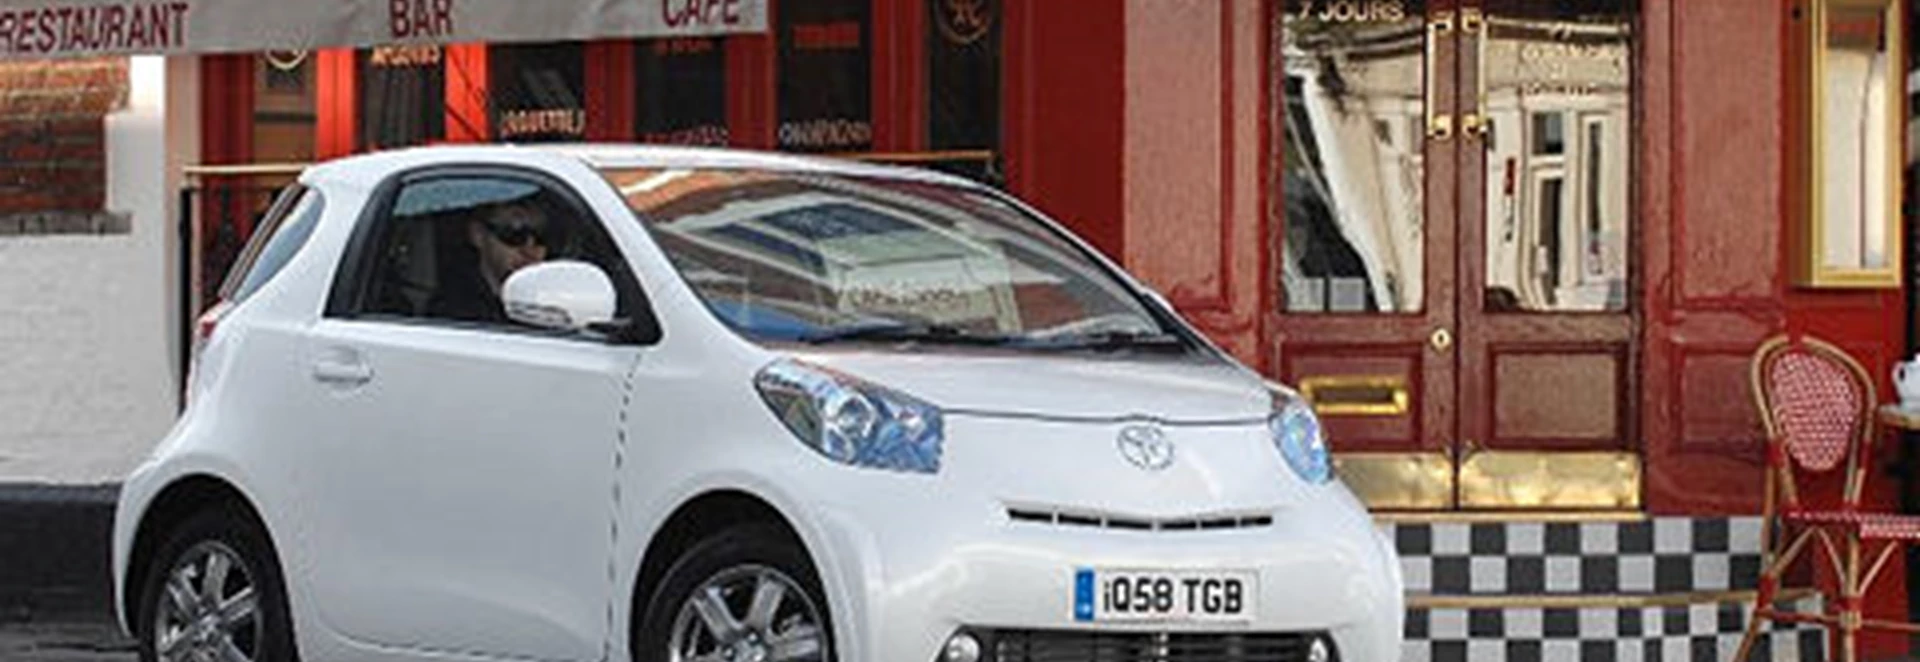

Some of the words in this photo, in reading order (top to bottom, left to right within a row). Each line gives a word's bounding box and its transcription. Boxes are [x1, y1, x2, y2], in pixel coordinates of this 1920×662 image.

[0, 3, 188, 51] RESTAURANT
[389, 0, 453, 38] BAR
[1318, 0, 1405, 22] JOURS
[1182, 578, 1244, 614] TGB
